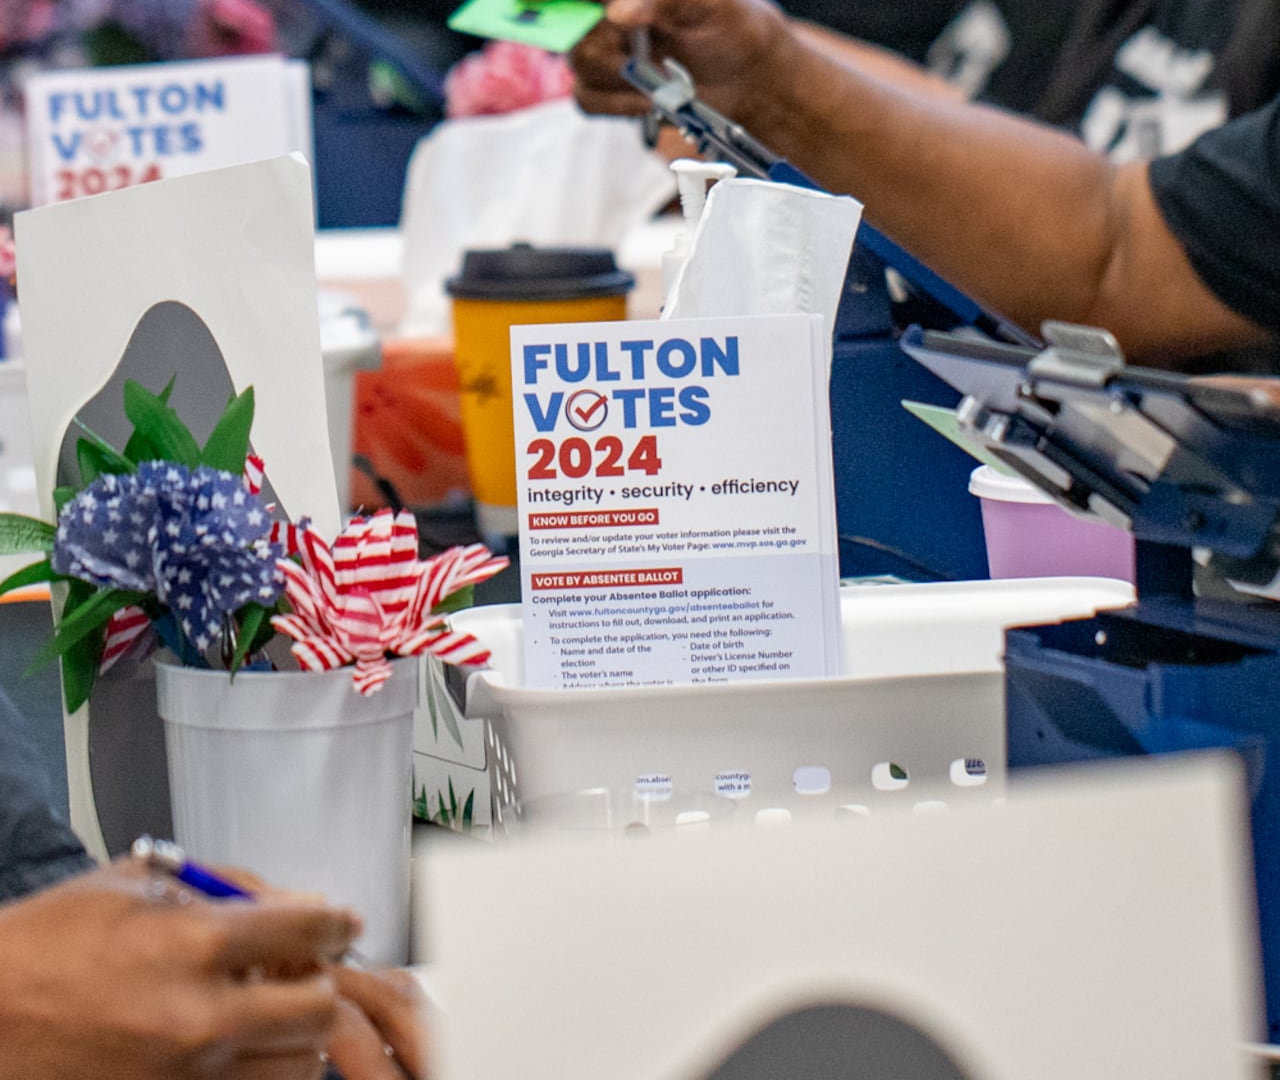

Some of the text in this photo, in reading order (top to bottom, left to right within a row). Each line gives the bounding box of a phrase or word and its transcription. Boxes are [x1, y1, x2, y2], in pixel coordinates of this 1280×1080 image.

[48, 81, 225, 123] FULTON
[523, 336, 740, 385] FULTON
[526, 435, 662, 480] 2024
[527, 478, 800, 505] integrity security efficiency
[533, 512, 654, 526] KNOW BEFORE YOU GO
[530, 526, 796, 544] To review and/or update your voter information please visit the
[530, 538, 807, 558] Georgia Secretary of State's My Voter Page: www.mvp.sos.ga.gov
[536, 572, 679, 587] VOTE BY ABSENTEE BALLOT
[532, 586, 752, 605] Complete your Absentee Ballot application:
[548, 600, 774, 618] Visit www.fultoncountyga.gov/absenteeballot for
[549, 620, 600, 630] instructions
[612, 618, 624, 626] fill
[625, 618, 642, 627] out,
[644, 616, 689, 626] download,
[690, 615, 708, 624] and
[710, 614, 730, 624] print
[744, 612, 795, 622] application.
[550, 628, 772, 646] To complete the application, you need the following:
[690, 640, 744, 650] Date of birth
[560, 644, 652, 656] Name and date of the
[690, 651, 792, 662] Driver's License Number
[561, 660, 596, 668] election
[702, 664, 725, 673] other
[727, 664, 736, 672] ID
[738, 663, 776, 674] specified
[562, 671, 578, 680] The
[579, 670, 608, 679] voter's
